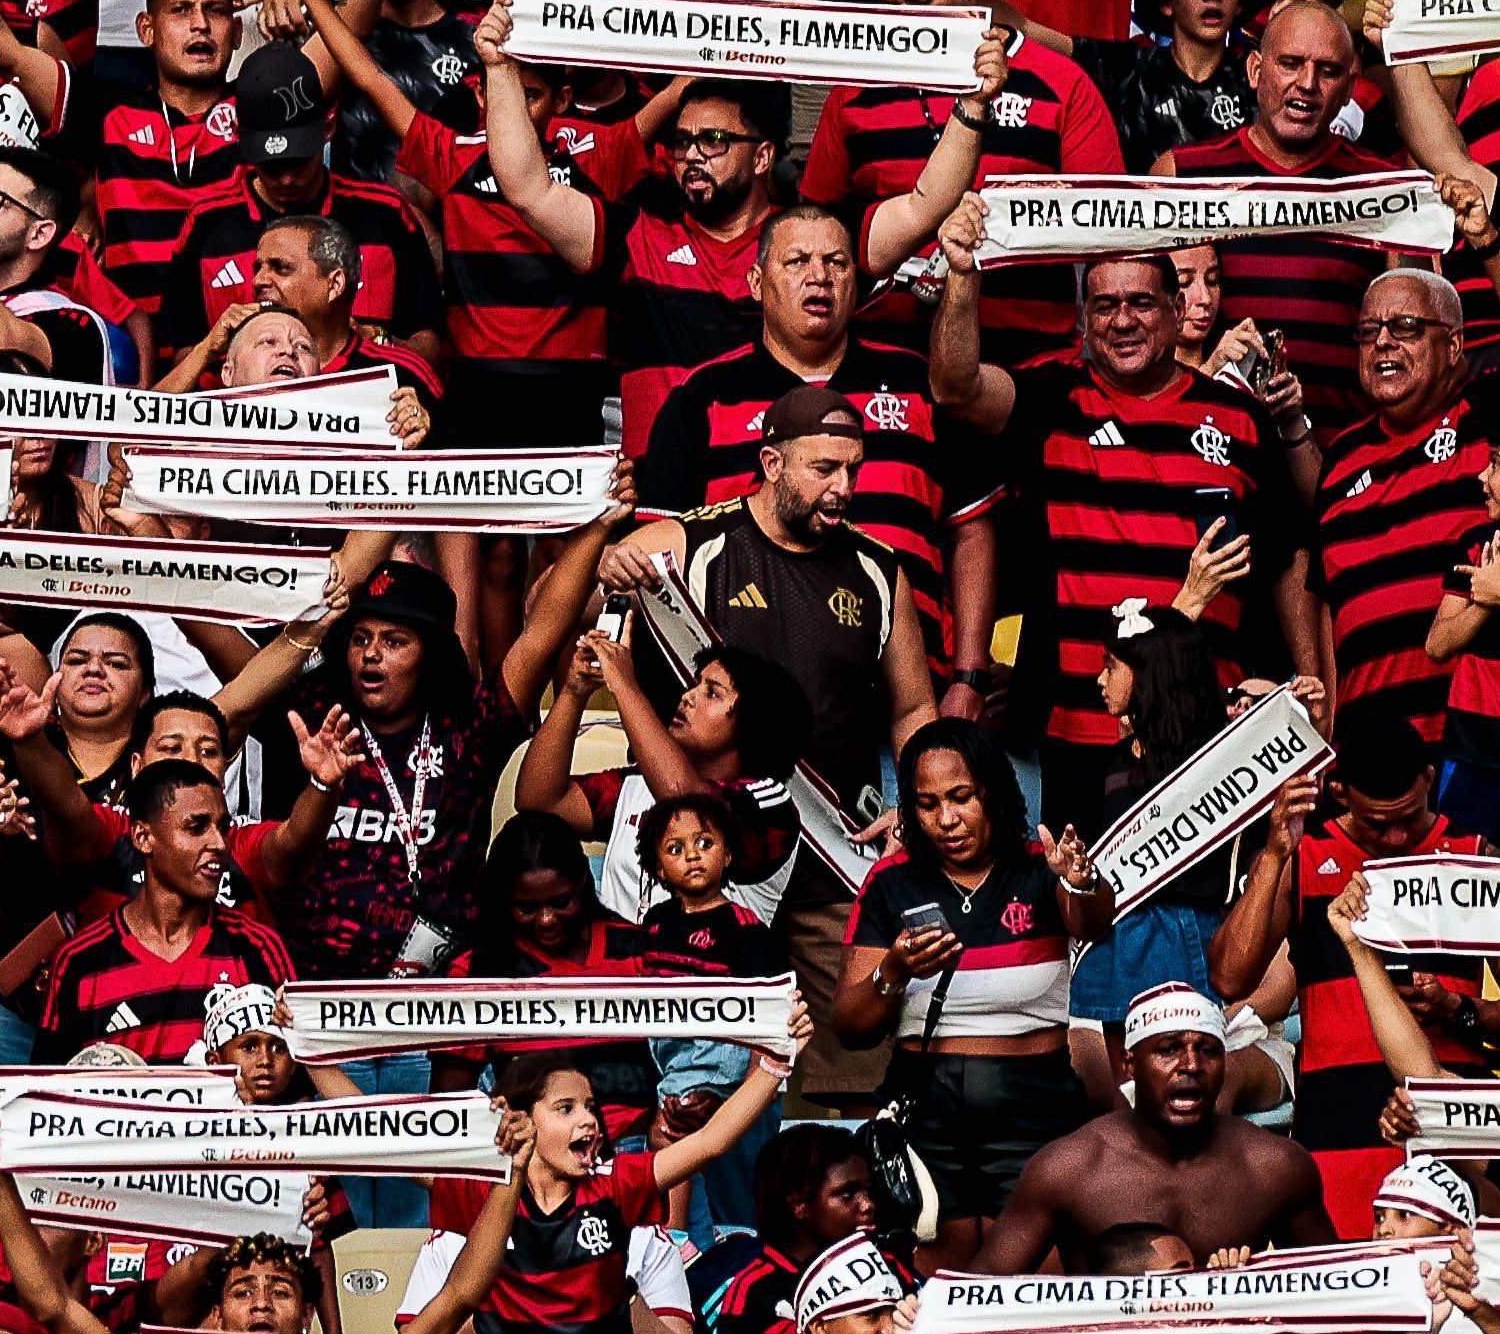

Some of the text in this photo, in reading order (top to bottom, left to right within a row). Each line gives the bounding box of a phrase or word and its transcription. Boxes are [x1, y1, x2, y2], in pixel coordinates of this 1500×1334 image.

[543, 3, 947, 54] PRA CIMA DELES, FLAMENGO!
[726, 51, 786, 64] Betano
[126, 391, 212, 427] DELES,
[1119, 725, 1308, 878] PRA CIMA DELES,
[320, 997, 755, 1029] PRA CIMA DELES, FLAMENGO!
[111, 1256, 142, 1272] BR
[357, 1275, 374, 1290] 13
